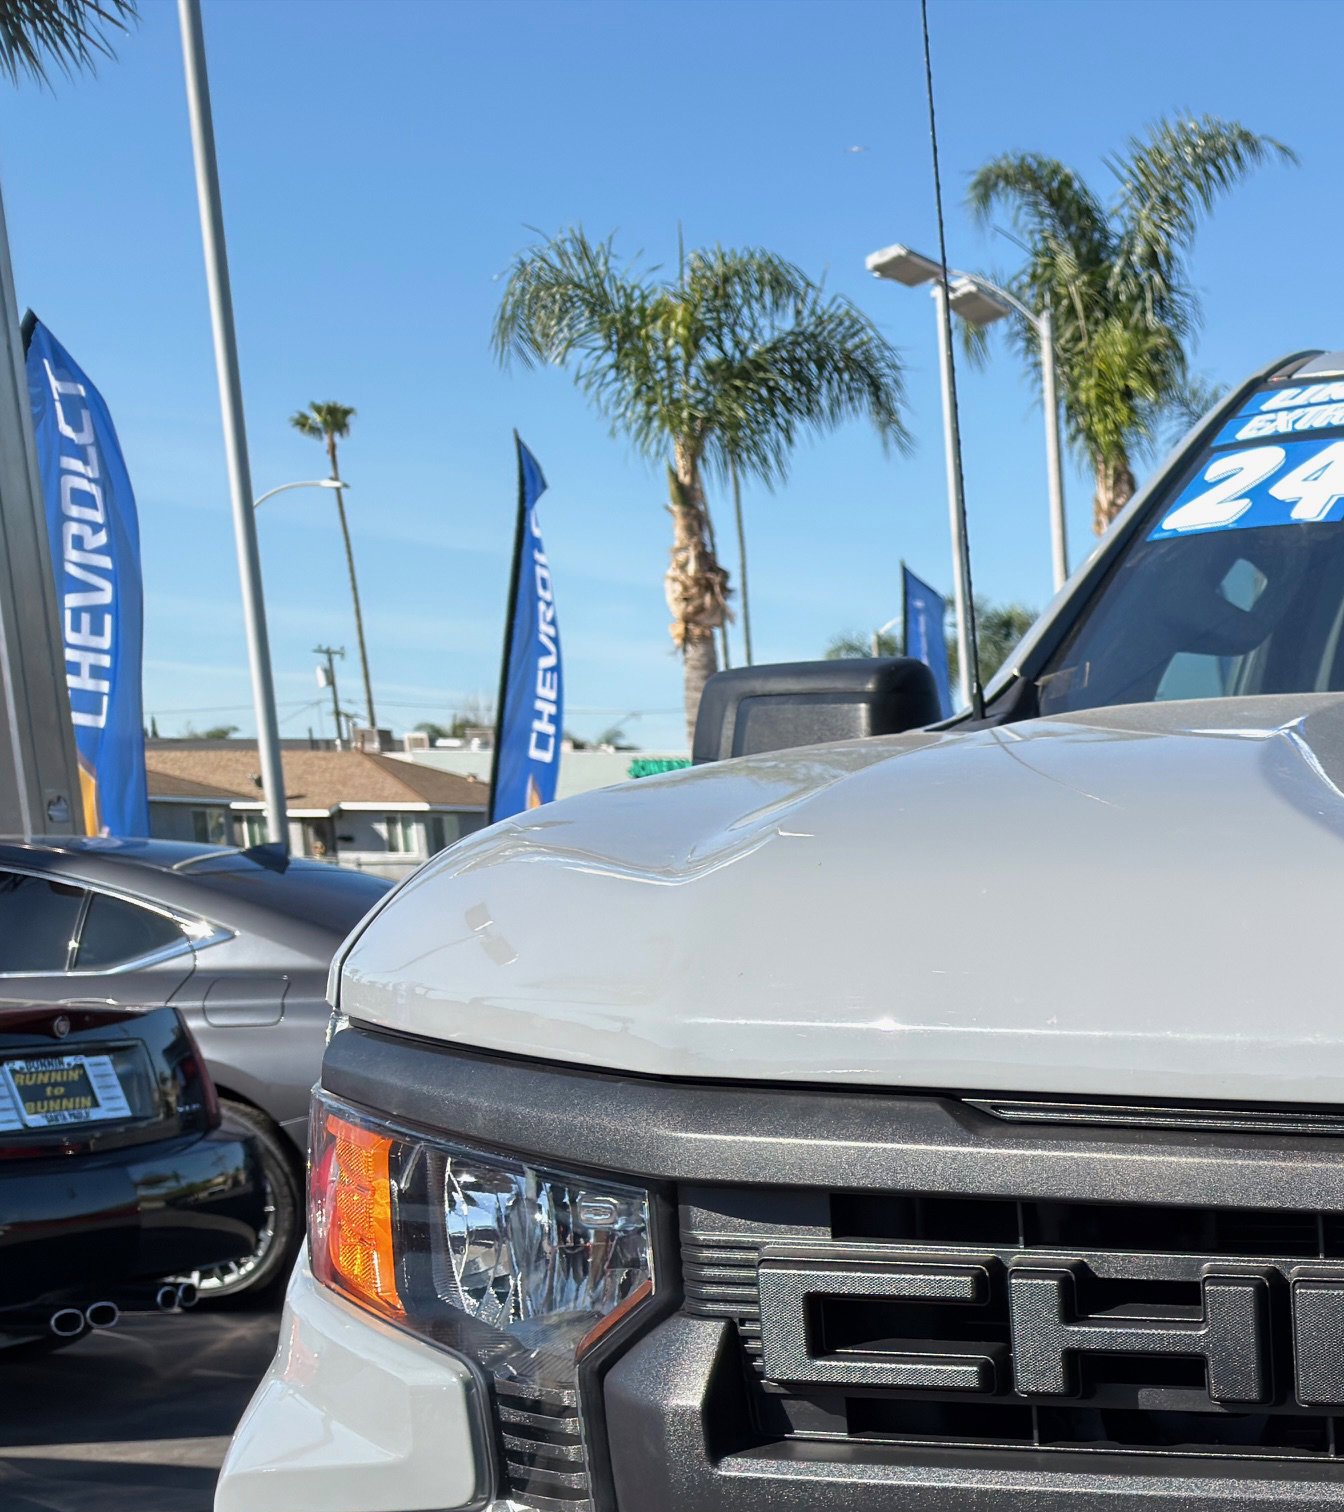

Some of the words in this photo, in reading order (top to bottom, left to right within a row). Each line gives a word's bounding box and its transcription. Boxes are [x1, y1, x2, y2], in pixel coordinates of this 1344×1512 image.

[15, 1068, 84, 1086] RUNNIN'
[46, 1086, 66, 1097] to
[25, 1096, 92, 1115] BUNNIN
